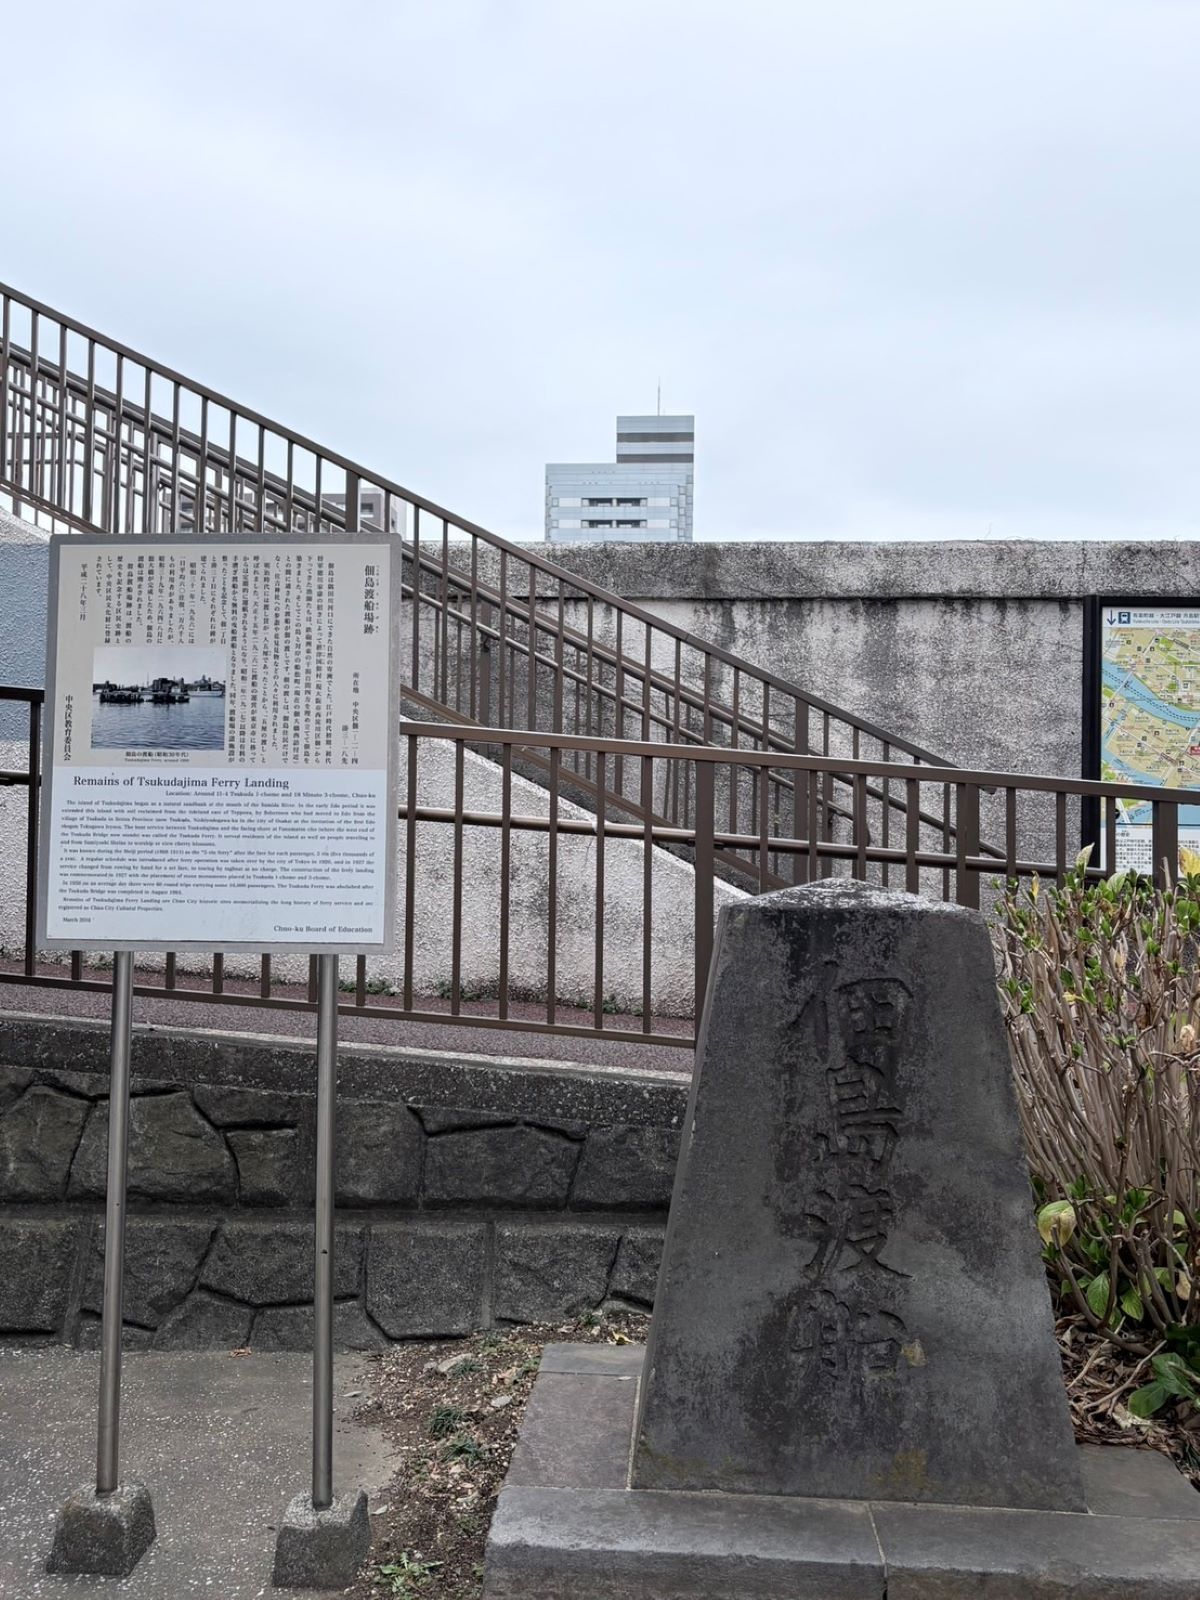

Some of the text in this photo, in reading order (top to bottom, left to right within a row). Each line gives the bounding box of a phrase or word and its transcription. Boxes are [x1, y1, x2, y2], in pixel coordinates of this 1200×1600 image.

[364, 565, 375, 634] 佃島渡船場跡
[64, 694, 73, 761] 中央区教育委員会
[74, 776, 289, 789] Remains of Tsukudajima Ferry Landing
[786, 961, 915, 1380] 佃島渡船
